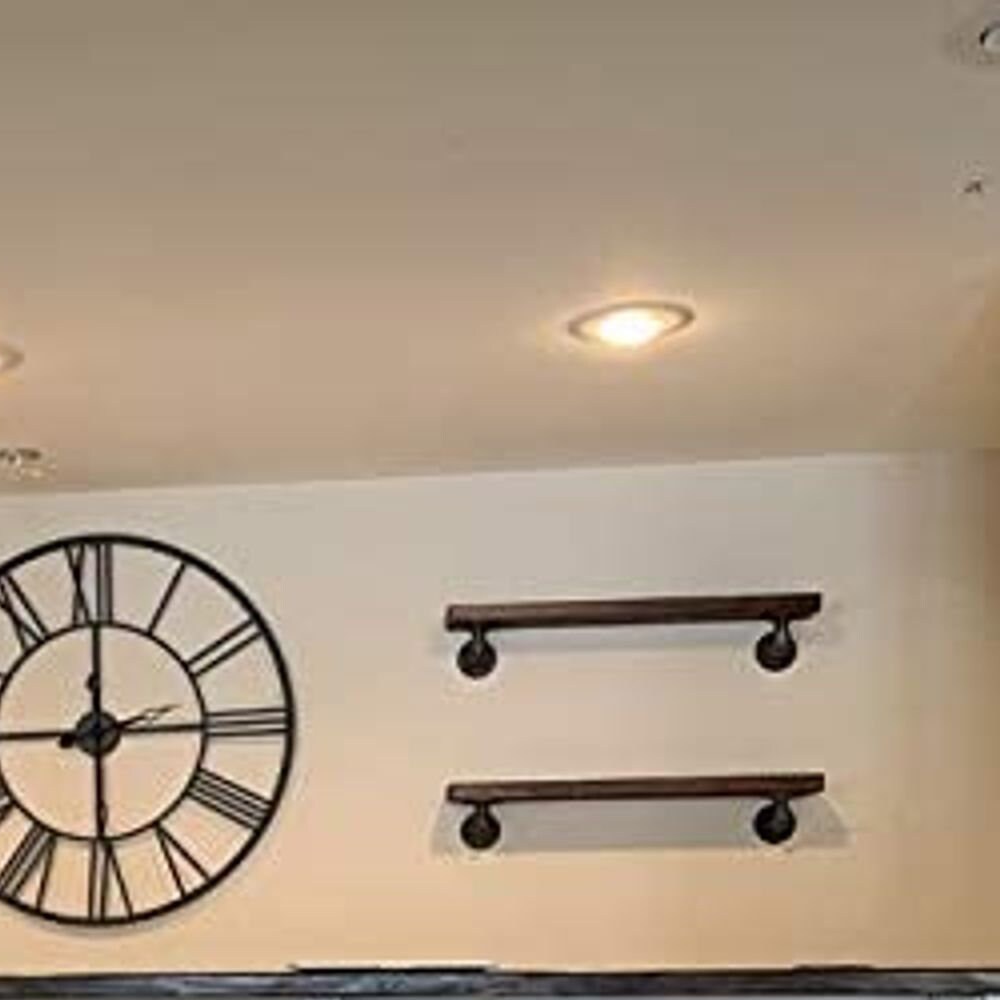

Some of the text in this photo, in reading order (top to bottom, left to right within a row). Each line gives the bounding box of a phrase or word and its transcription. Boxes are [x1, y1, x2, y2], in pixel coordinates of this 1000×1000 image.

[186, 618, 262, 676] II
[203, 708, 292, 737] III
[187, 769, 273, 830] IIII
[88, 840, 134, 920] VI
[156, 822, 212, 896] V
